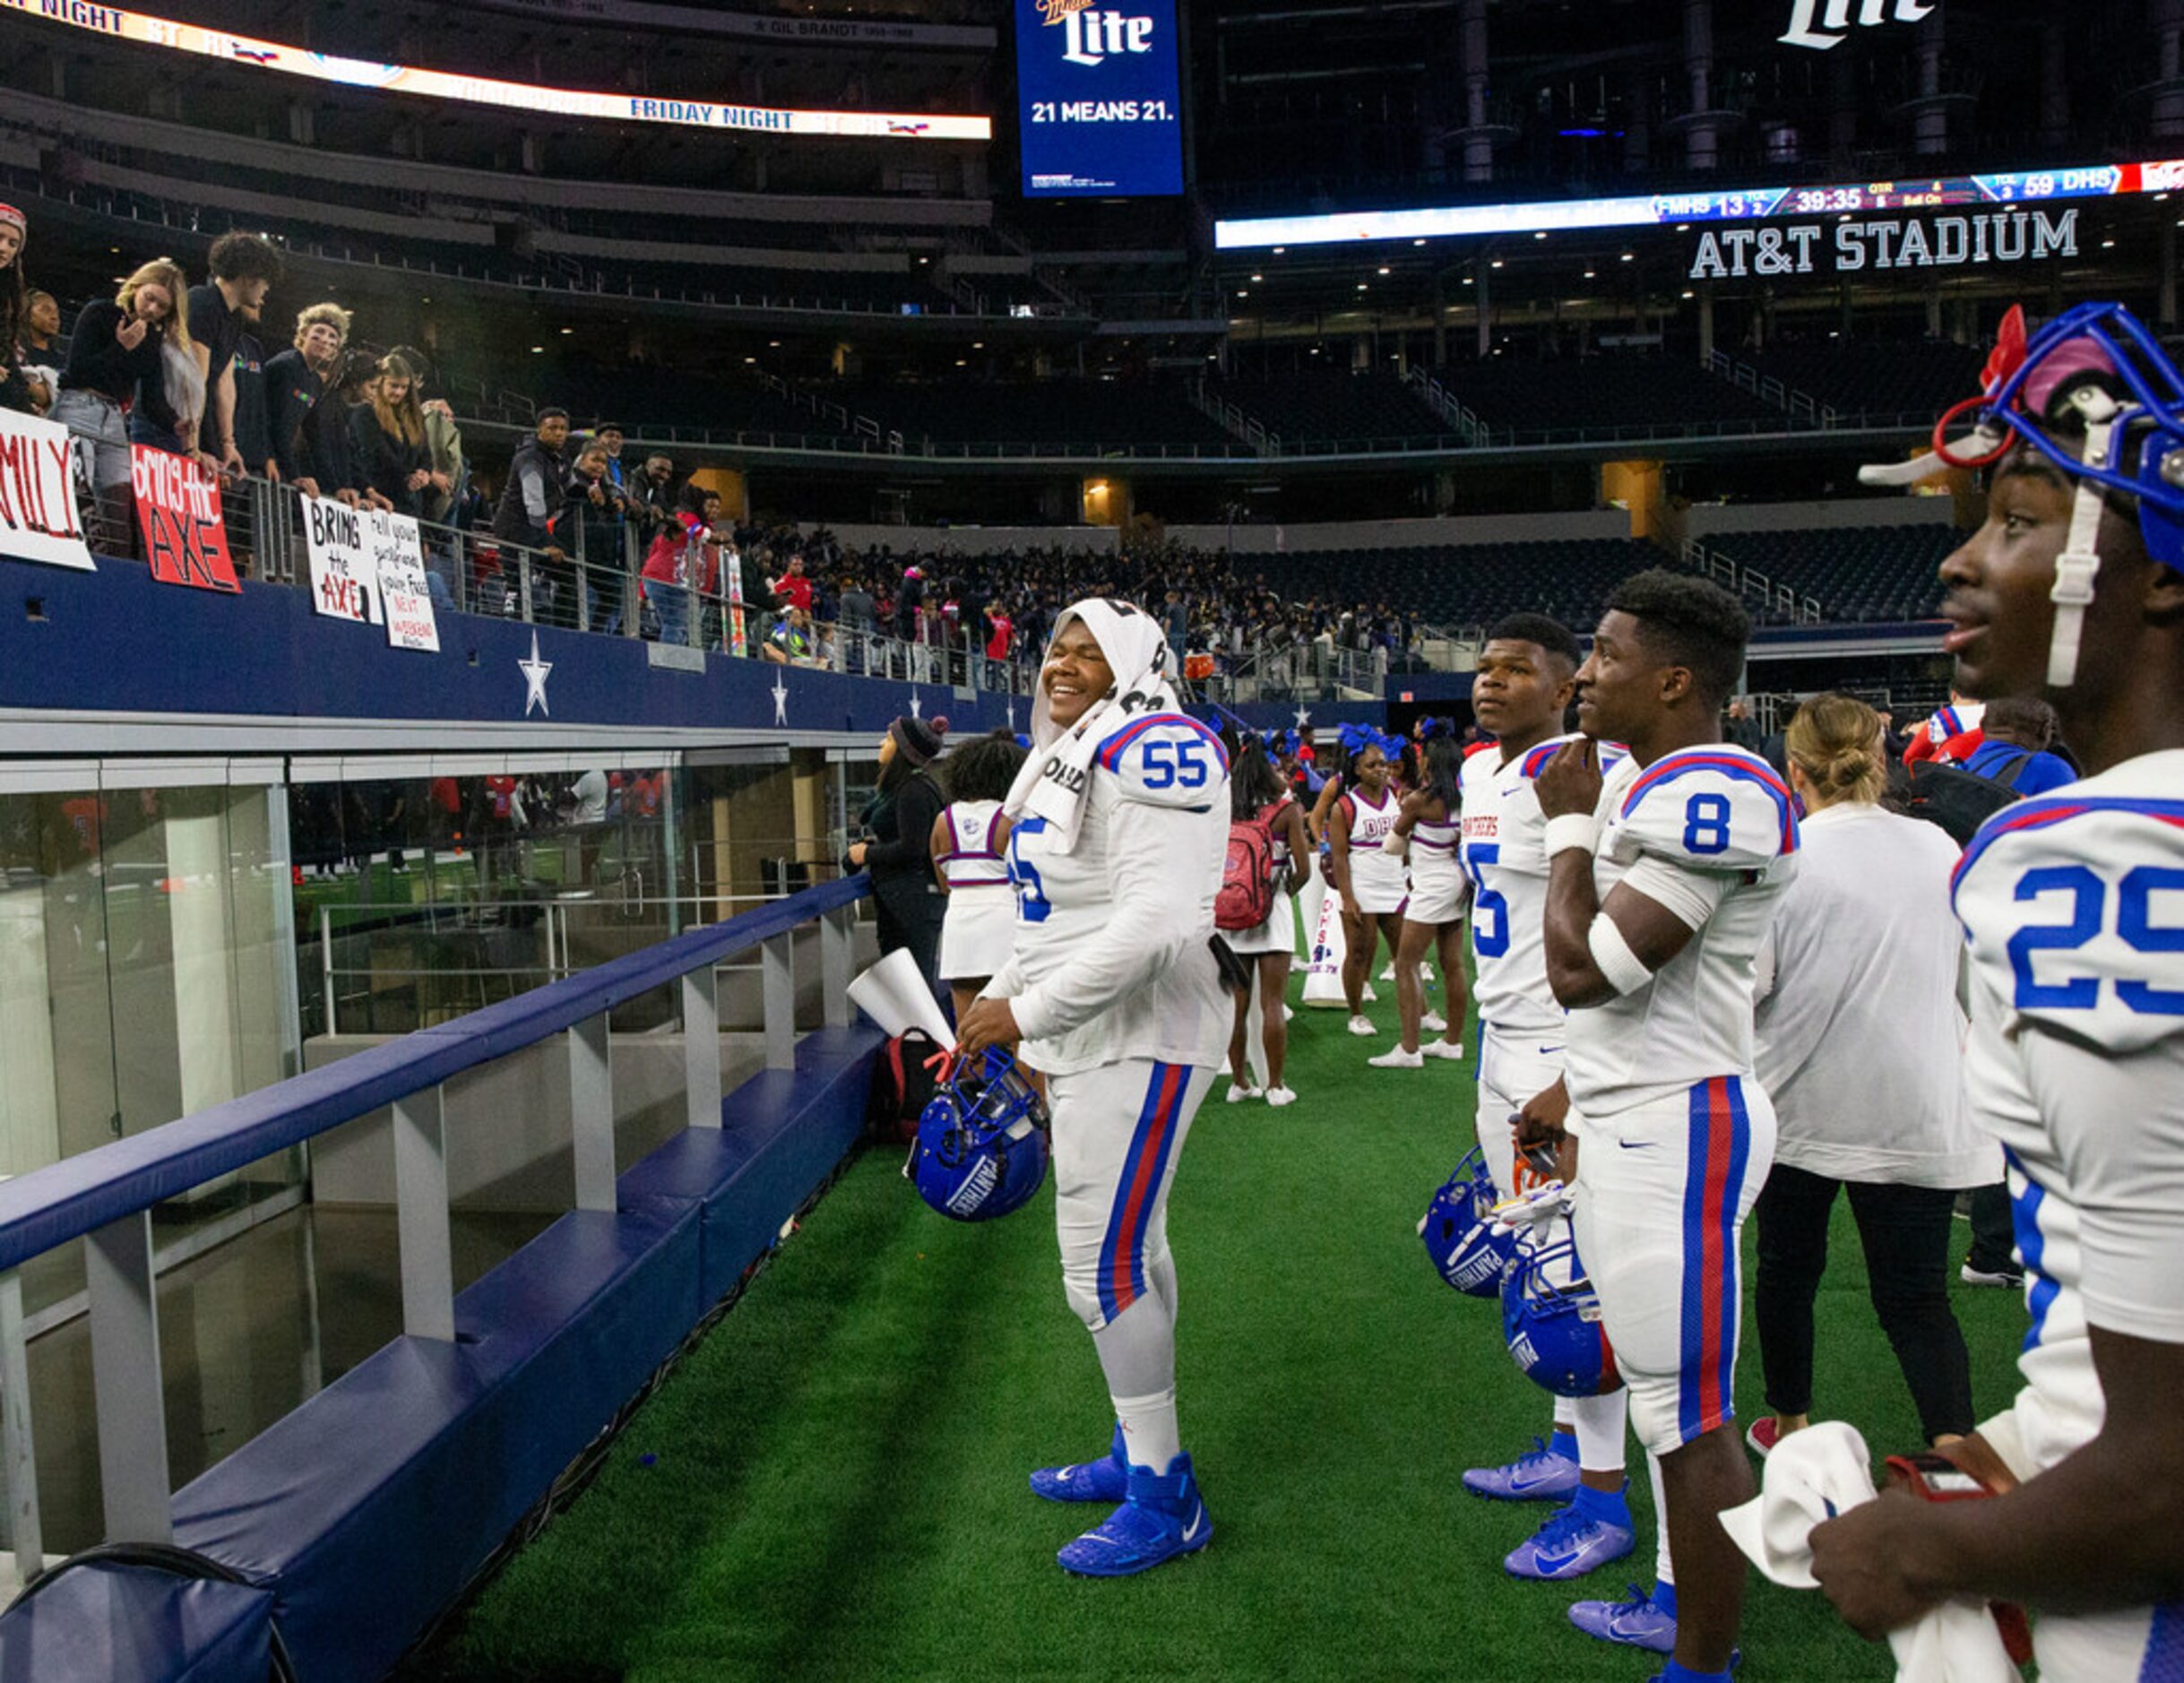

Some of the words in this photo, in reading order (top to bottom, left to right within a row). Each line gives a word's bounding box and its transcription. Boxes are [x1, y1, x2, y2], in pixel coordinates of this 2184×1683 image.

[41, 0, 124, 33] NIGHT
[771, 22, 794, 34] GIL
[798, 23, 858, 37] BRANDT
[1062, 11, 1153, 65] Lite
[630, 98, 712, 123] FRIDAY
[722, 107, 794, 130] NIGHT
[1032, 102, 1056, 123] 21
[1061, 100, 1140, 123] MEANS
[1142, 99, 1174, 121] 21.
[2001, 186, 2013, 199] 3
[2024, 175, 2055, 196] 59
[2063, 168, 2110, 190] DHS
[1658, 195, 1710, 217] FMHS
[1716, 194, 1747, 217] 13
[1751, 202, 1764, 215] 2
[1796, 188, 1863, 213] 39:35
[1689, 225, 1822, 279] AT&T
[1835, 209, 2080, 271] STADIUM
[131, 444, 185, 514] bring
[310, 500, 361, 550] BRING
[150, 505, 235, 590] AXE
[328, 548, 349, 576] the
[322, 573, 361, 618] AXE
[1142, 738, 1209, 790] 55
[1682, 793, 1731, 855] 8
[1007, 816, 1052, 924] 5
[1458, 842, 1511, 958] 5
[2007, 865, 2184, 1015] 29
